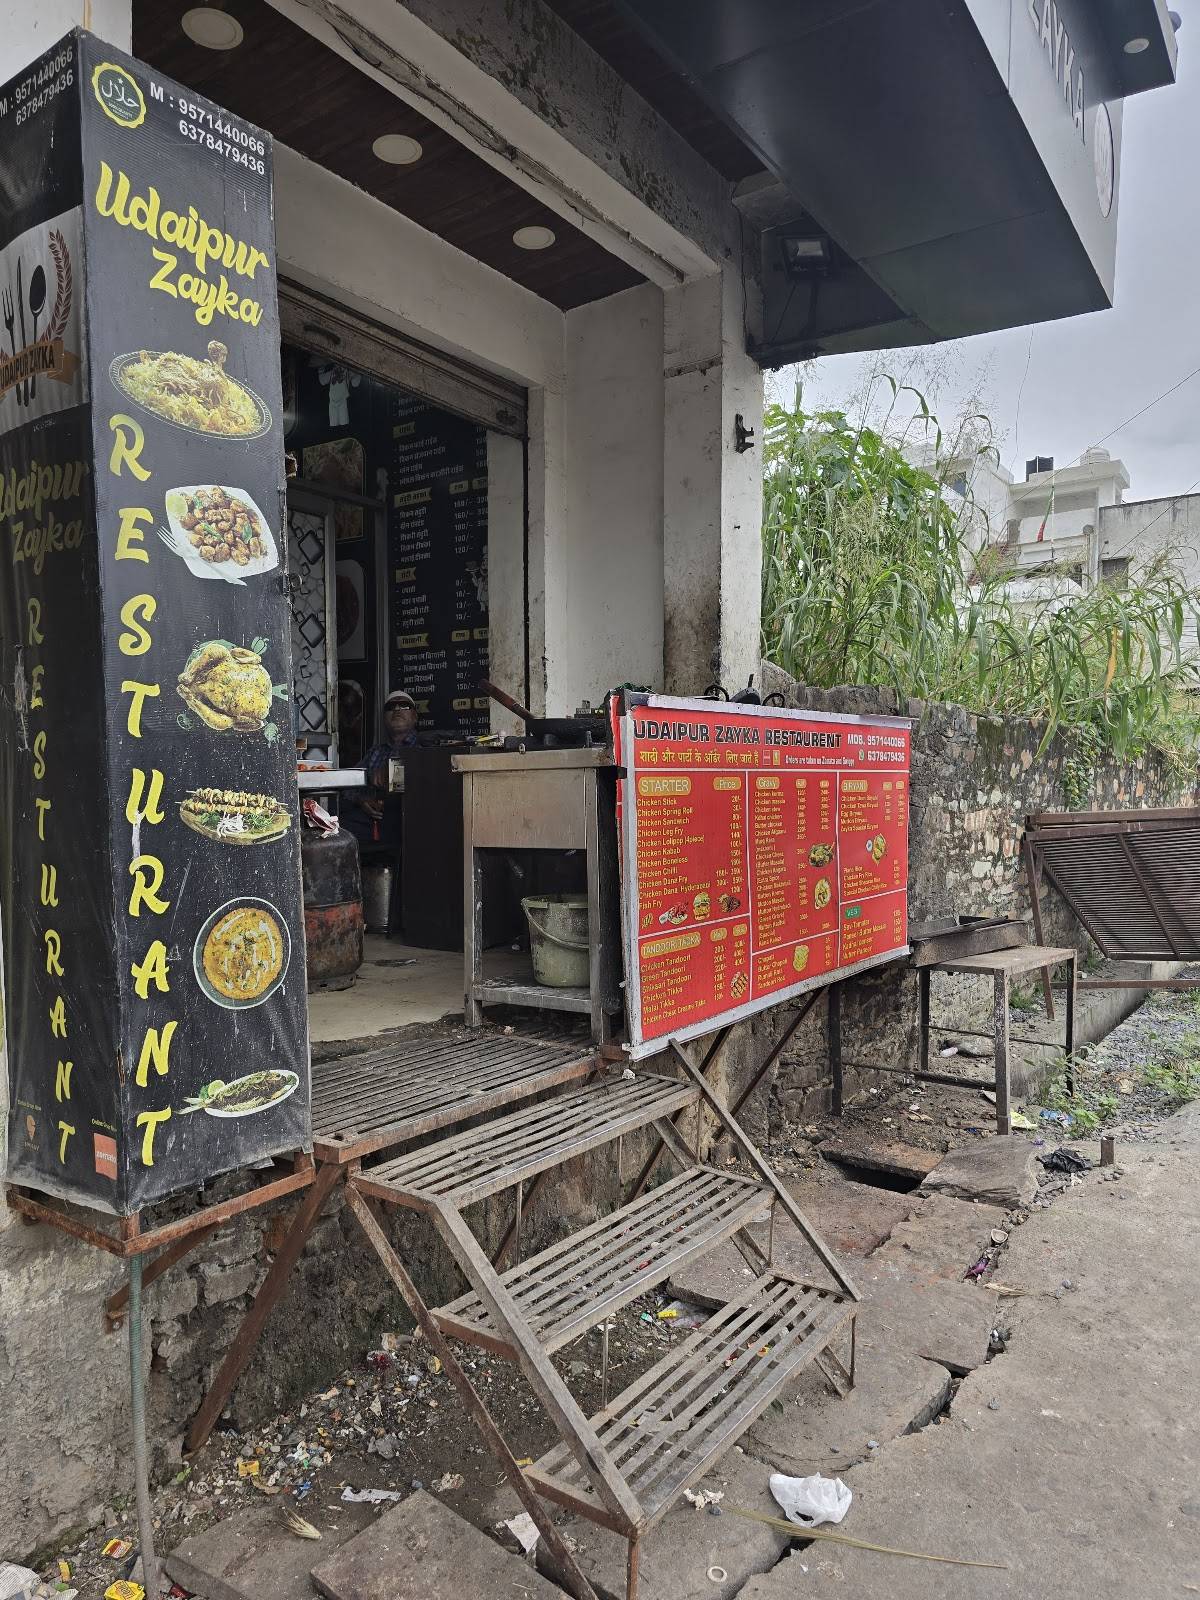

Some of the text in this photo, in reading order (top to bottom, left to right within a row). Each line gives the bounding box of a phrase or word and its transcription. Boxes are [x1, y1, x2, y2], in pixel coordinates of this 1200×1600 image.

[15, 46, 73, 105] 9571440066
[1028, 0, 1085, 146] AYKA
[15, 68, 74, 126] 6378479436
[150, 82, 164, 103] M
[179, 98, 265, 157] 9571440066
[179, 120, 265, 175] 6378479436
[95, 160, 270, 280] Udaipur
[149, 246, 264, 326] Zayka
[12, 511, 84, 576] Zayka
[634, 719, 842, 749] UDAIPUR ZAYKA RESTAURENT
[640, 747, 658, 764] शादी
[662, 747, 676, 762] और
[694, 748, 701, 762] के
[726, 750, 738, 765] लिए
[740, 750, 752, 764] जाते
[641, 779, 689, 792] STARTER
[637, 797, 677, 806] Chicken Stick
[637, 808, 662, 817] Chicken
[637, 818, 662, 827] Chicken
[638, 829, 662, 837] Chicken
[638, 839, 662, 847] Chicken
[638, 850, 662, 858] Chicken
[638, 860, 662, 869] Chicken
[638, 870, 662, 879] Chicken
[639, 880, 662, 889] Chicken
[639, 890, 662, 900] Chicken
